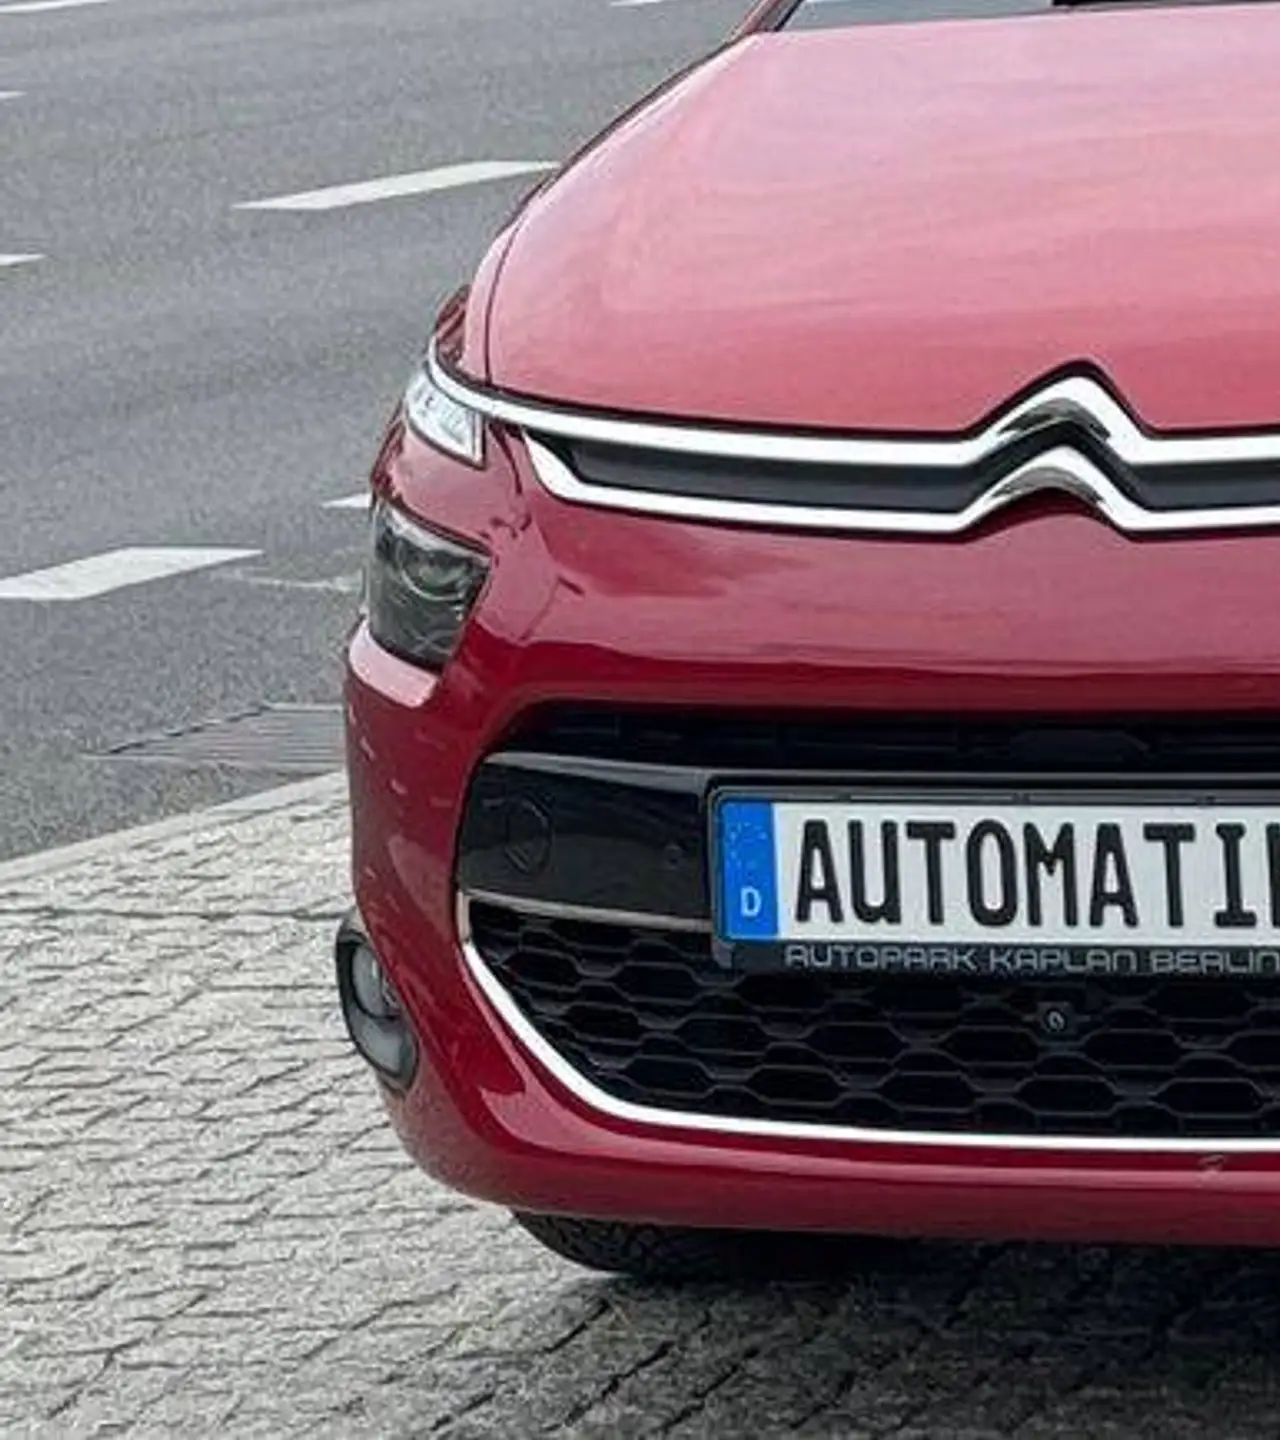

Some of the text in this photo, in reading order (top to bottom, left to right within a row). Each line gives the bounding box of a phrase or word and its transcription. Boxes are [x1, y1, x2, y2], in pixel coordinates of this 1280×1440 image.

[739, 887, 762, 918] D
[784, 943, 978, 972] AUTOPARK
[988, 946, 1138, 974] KAPLAN
